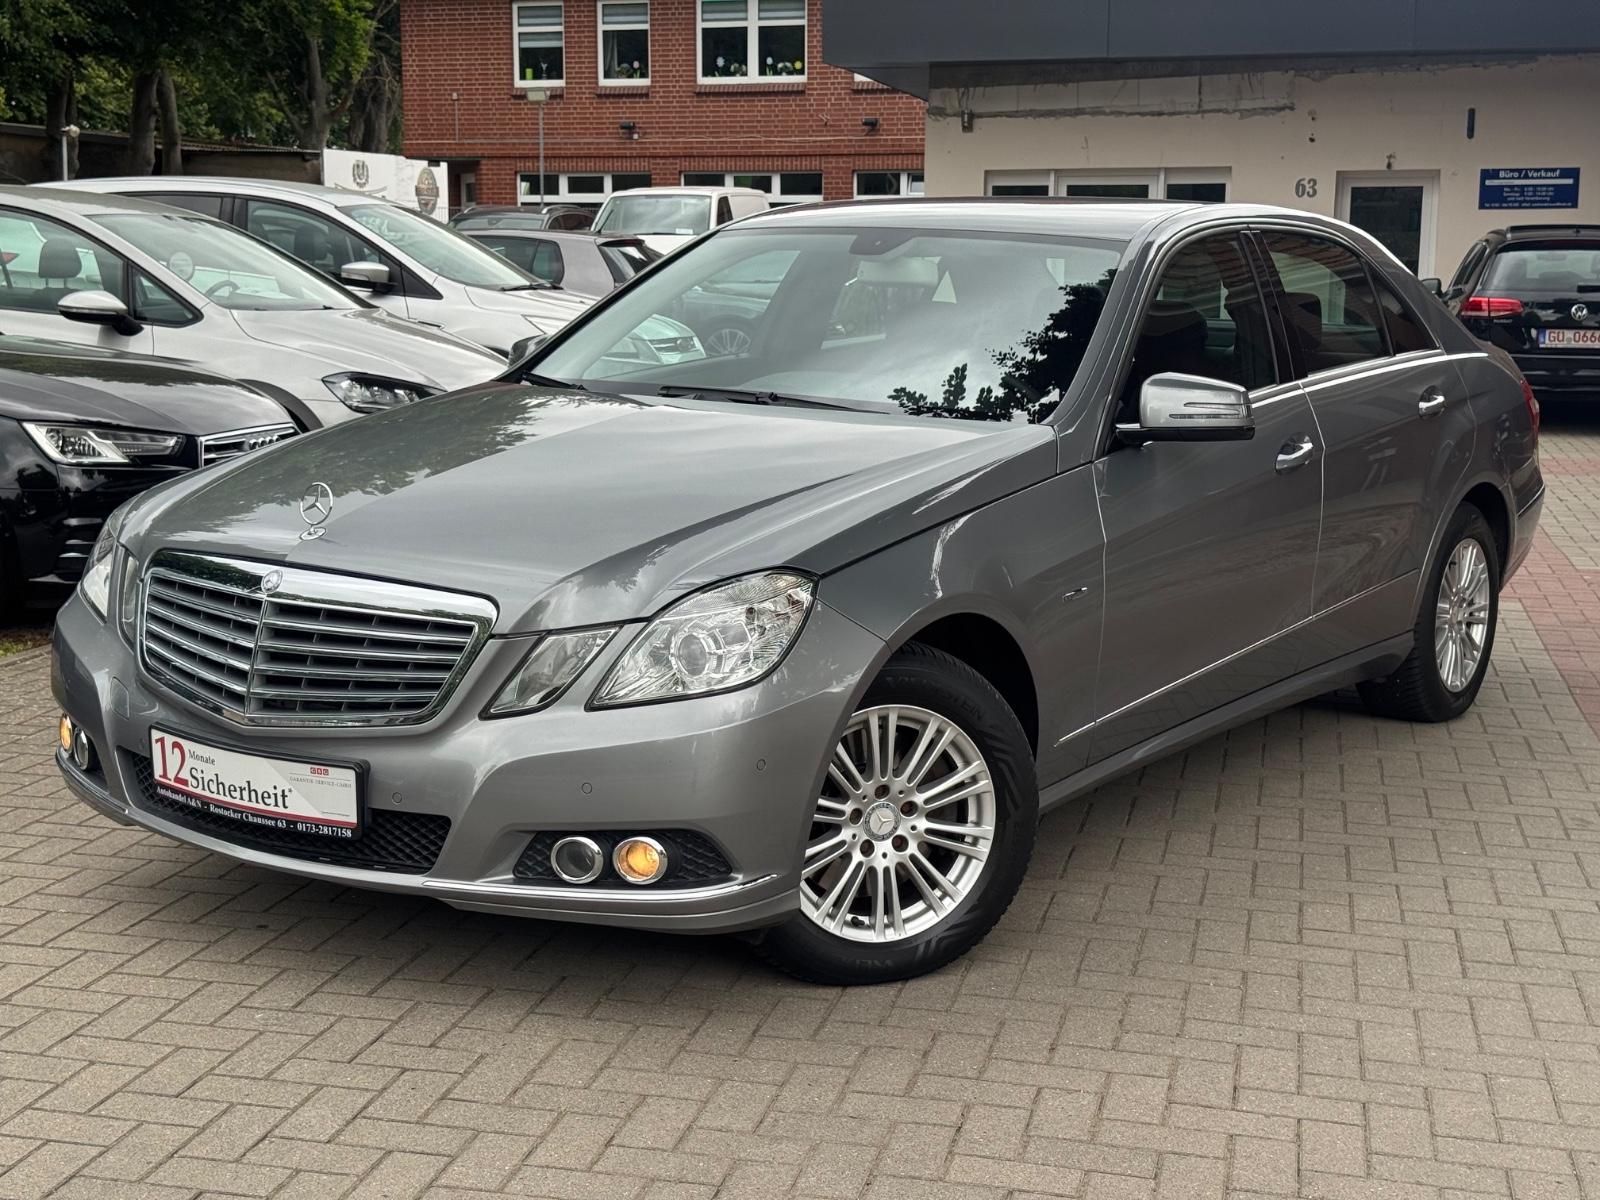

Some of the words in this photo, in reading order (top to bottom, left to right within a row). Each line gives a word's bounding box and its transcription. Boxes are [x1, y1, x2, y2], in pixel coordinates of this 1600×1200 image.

[1499, 170, 1519, 178] Büro
[1527, 169, 1560, 178] Verkauf
[1295, 177, 1318, 198] 63
[155, 736, 189, 788] 12
[188, 749, 216, 766] Monate
[156, 785, 187, 804] Autohandel
[186, 796, 202, 809] A&N
[209, 803, 242, 820] Rostocker
[242, 812, 276, 828] Chaussee
[277, 819, 287, 829] 63
[297, 822, 352, 838] 0173-2817158
